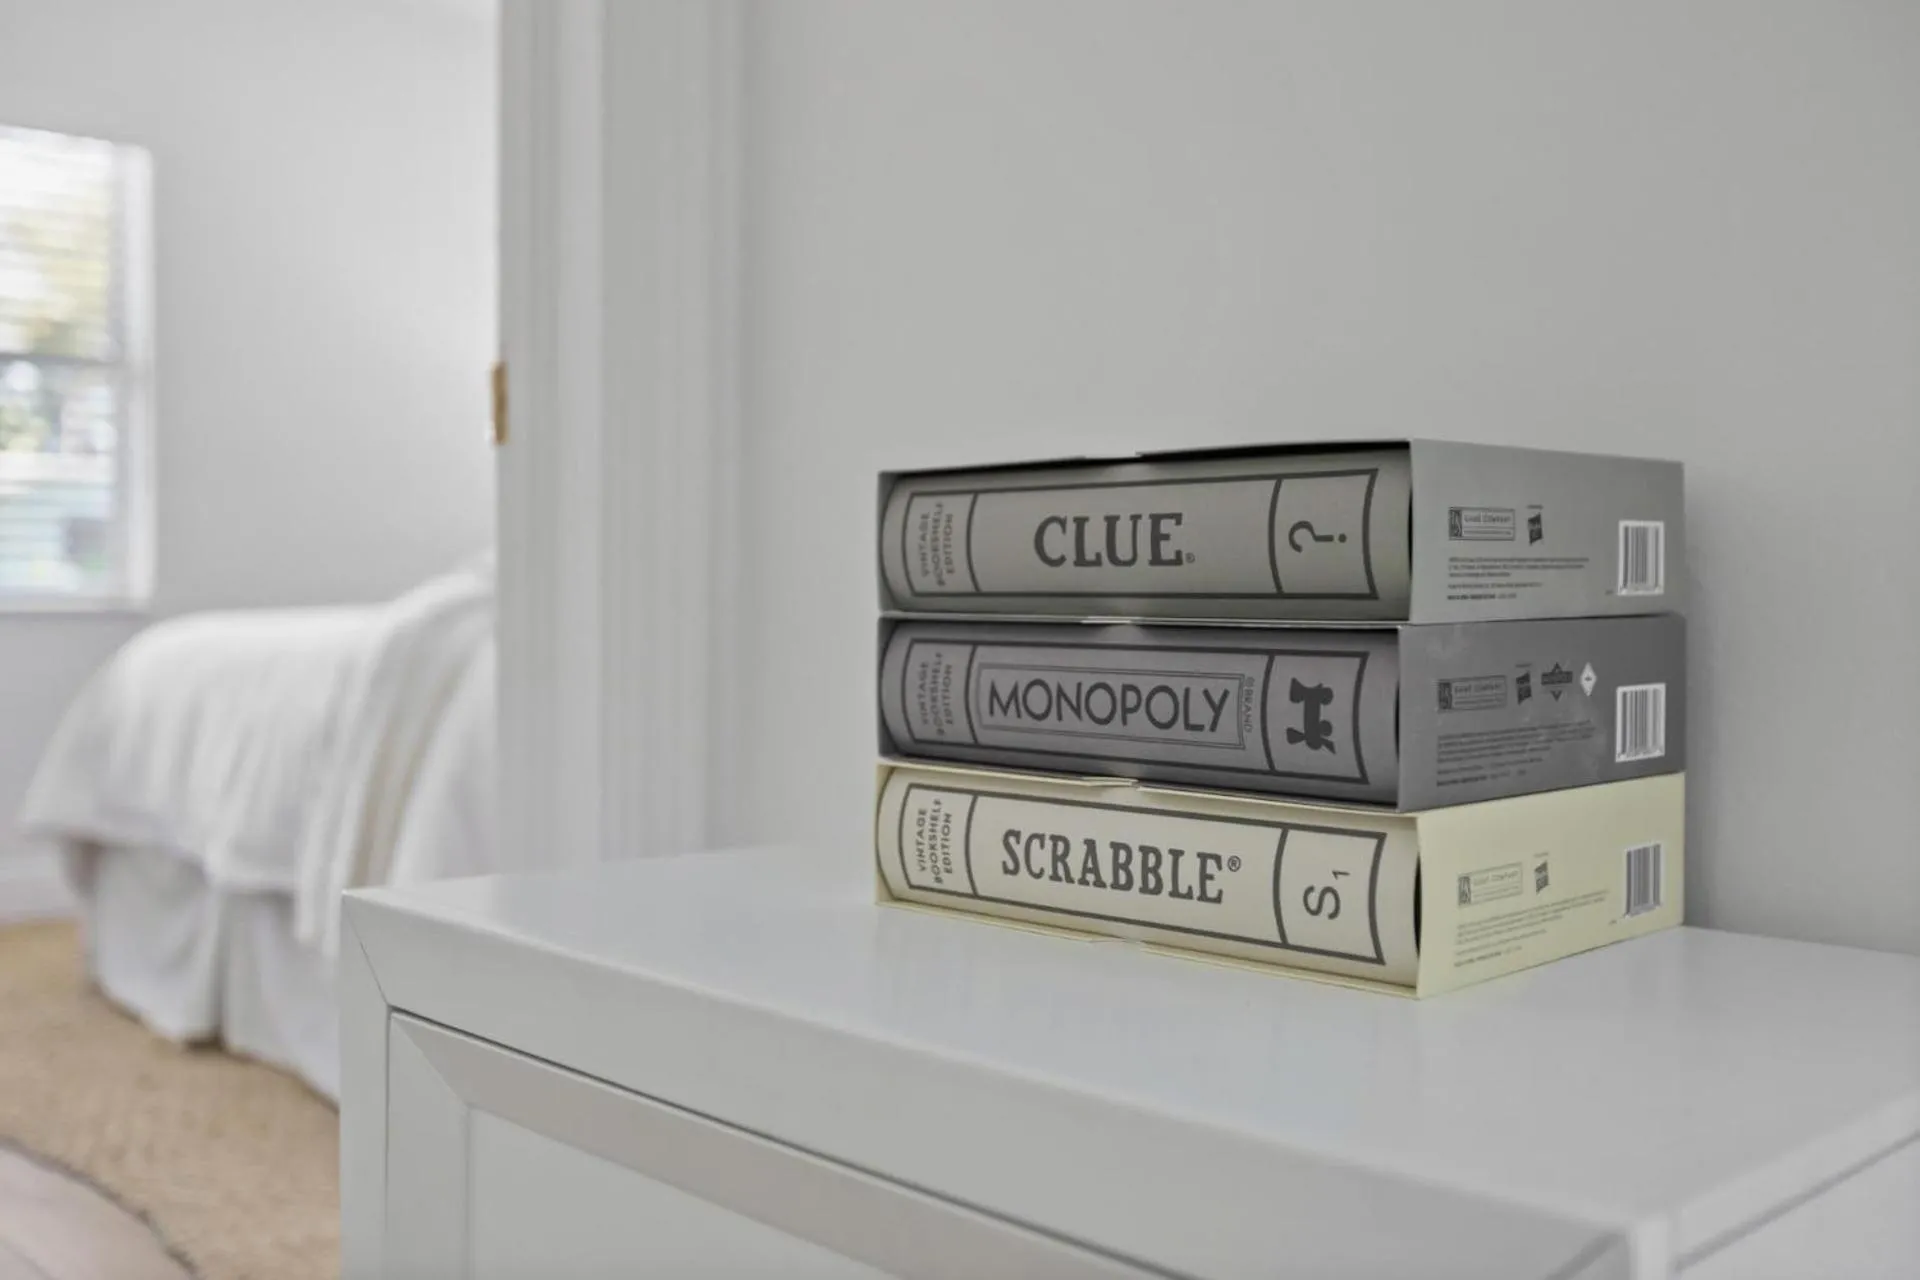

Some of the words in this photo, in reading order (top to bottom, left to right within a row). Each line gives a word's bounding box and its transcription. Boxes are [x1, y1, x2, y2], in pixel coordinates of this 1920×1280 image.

[918, 512, 930, 577] VINTAGE
[931, 502, 946, 587] BOOKSHELF
[943, 513, 955, 574] EDITION
[1288, 520, 1347, 553] ?
[917, 661, 928, 726] VINTAGE
[930, 652, 945, 736] BOOKSHELF
[941, 664, 953, 725] EDITION
[989, 678, 1230, 732] MONOPOLY
[915, 807, 927, 872] VINTAGE
[928, 798, 943, 884] BOOKSHELF
[940, 812, 952, 875] EDITION
